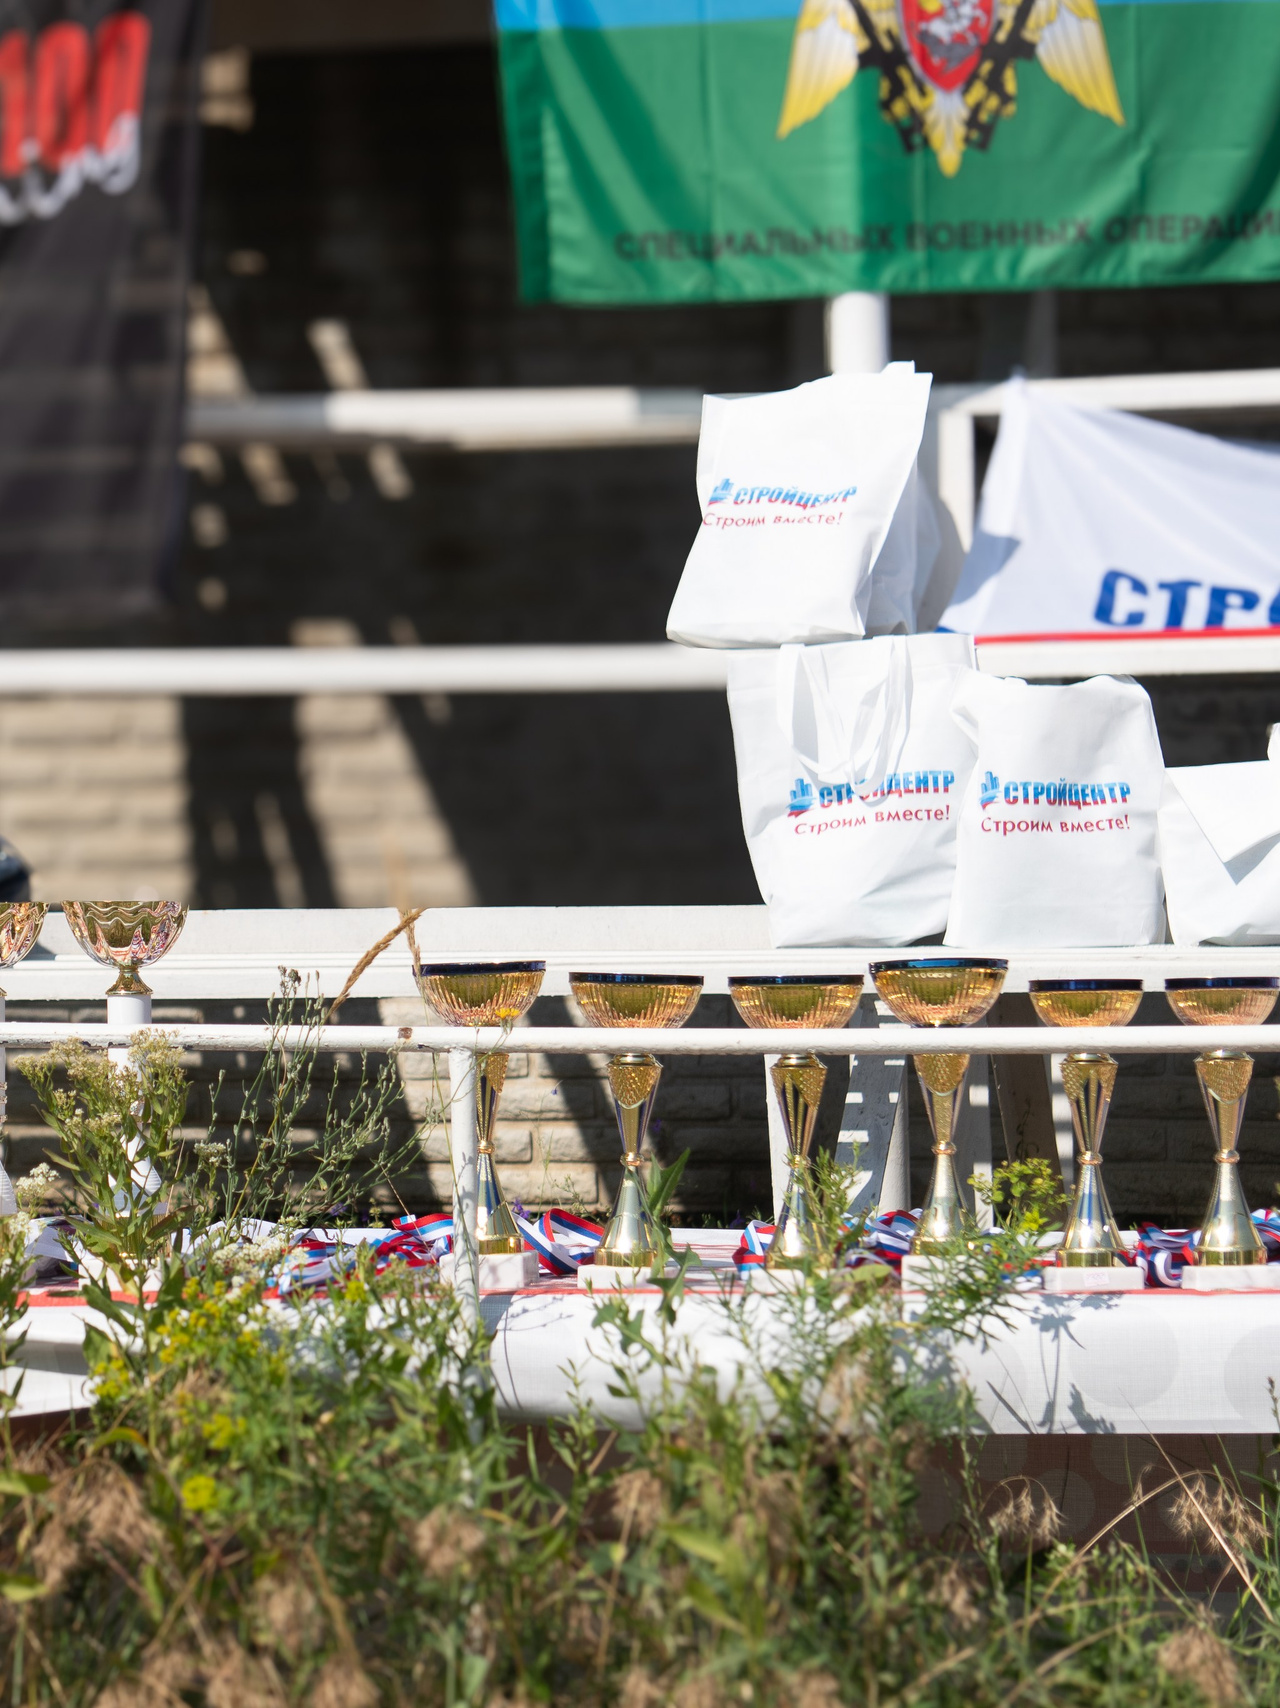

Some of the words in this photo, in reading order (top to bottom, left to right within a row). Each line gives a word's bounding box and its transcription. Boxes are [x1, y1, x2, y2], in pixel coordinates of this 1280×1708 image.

[614, 221, 897, 262] СПЕЦИАЛЬНЫХ
[906, 216, 1093, 253] ВОЕННЫХ
[1103, 207, 1280, 246] ОПЕРАЦИ
[702, 512, 766, 530] Строим
[773, 512, 844, 526] вместе!
[1093, 568, 1280, 632] СТР
[1003, 778, 1131, 809] СТРОЙЦЕНТР
[794, 814, 867, 835] Строим
[875, 804, 950, 823] вместе!
[981, 817, 1054, 836] Строим
[1060, 814, 1131, 834] вместе!
